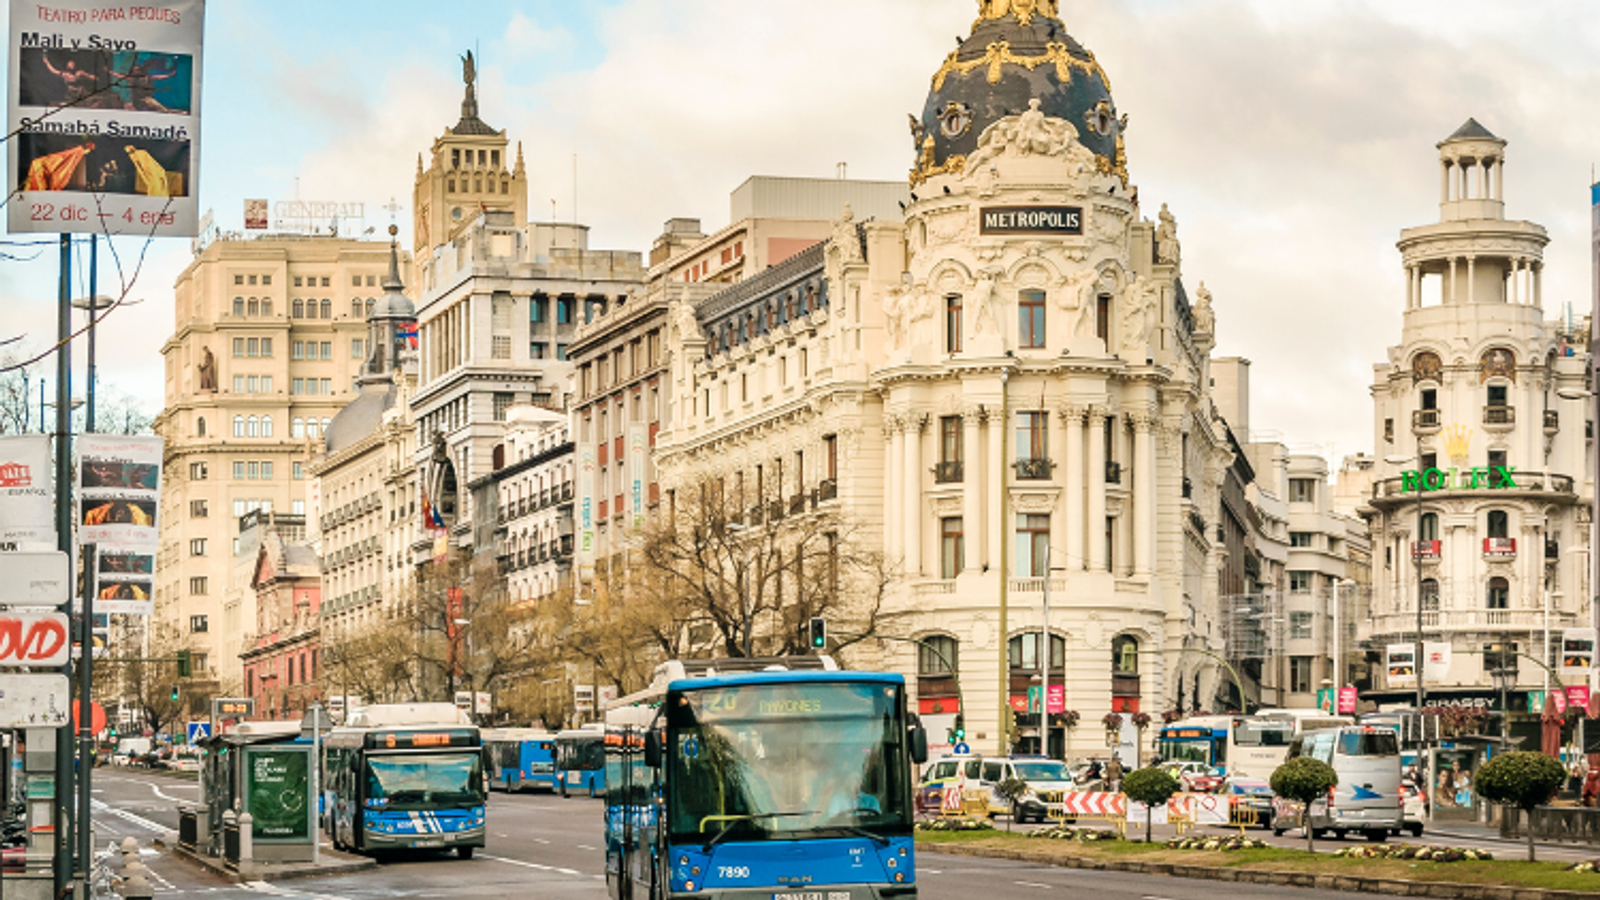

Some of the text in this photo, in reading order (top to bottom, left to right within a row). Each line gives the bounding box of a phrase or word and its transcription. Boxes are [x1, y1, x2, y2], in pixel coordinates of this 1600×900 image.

[37, 5, 181, 25] TEATRO PARA PEQUES
[21, 32, 136, 51] Mali y Sayo
[20, 117, 188, 140] Samabá Samadé
[30, 203, 54, 221] 22
[60, 204, 89, 221] dic
[122, 207, 133, 223] 4
[273, 200, 365, 218] GENERALI
[985, 211, 1079, 228] METROPOLIS
[1400, 465, 1518, 492] ROLEX
[582, 531, 594, 551] hay
[1425, 697, 1496, 708] GRASSY
[718, 866, 750, 878] 7890
